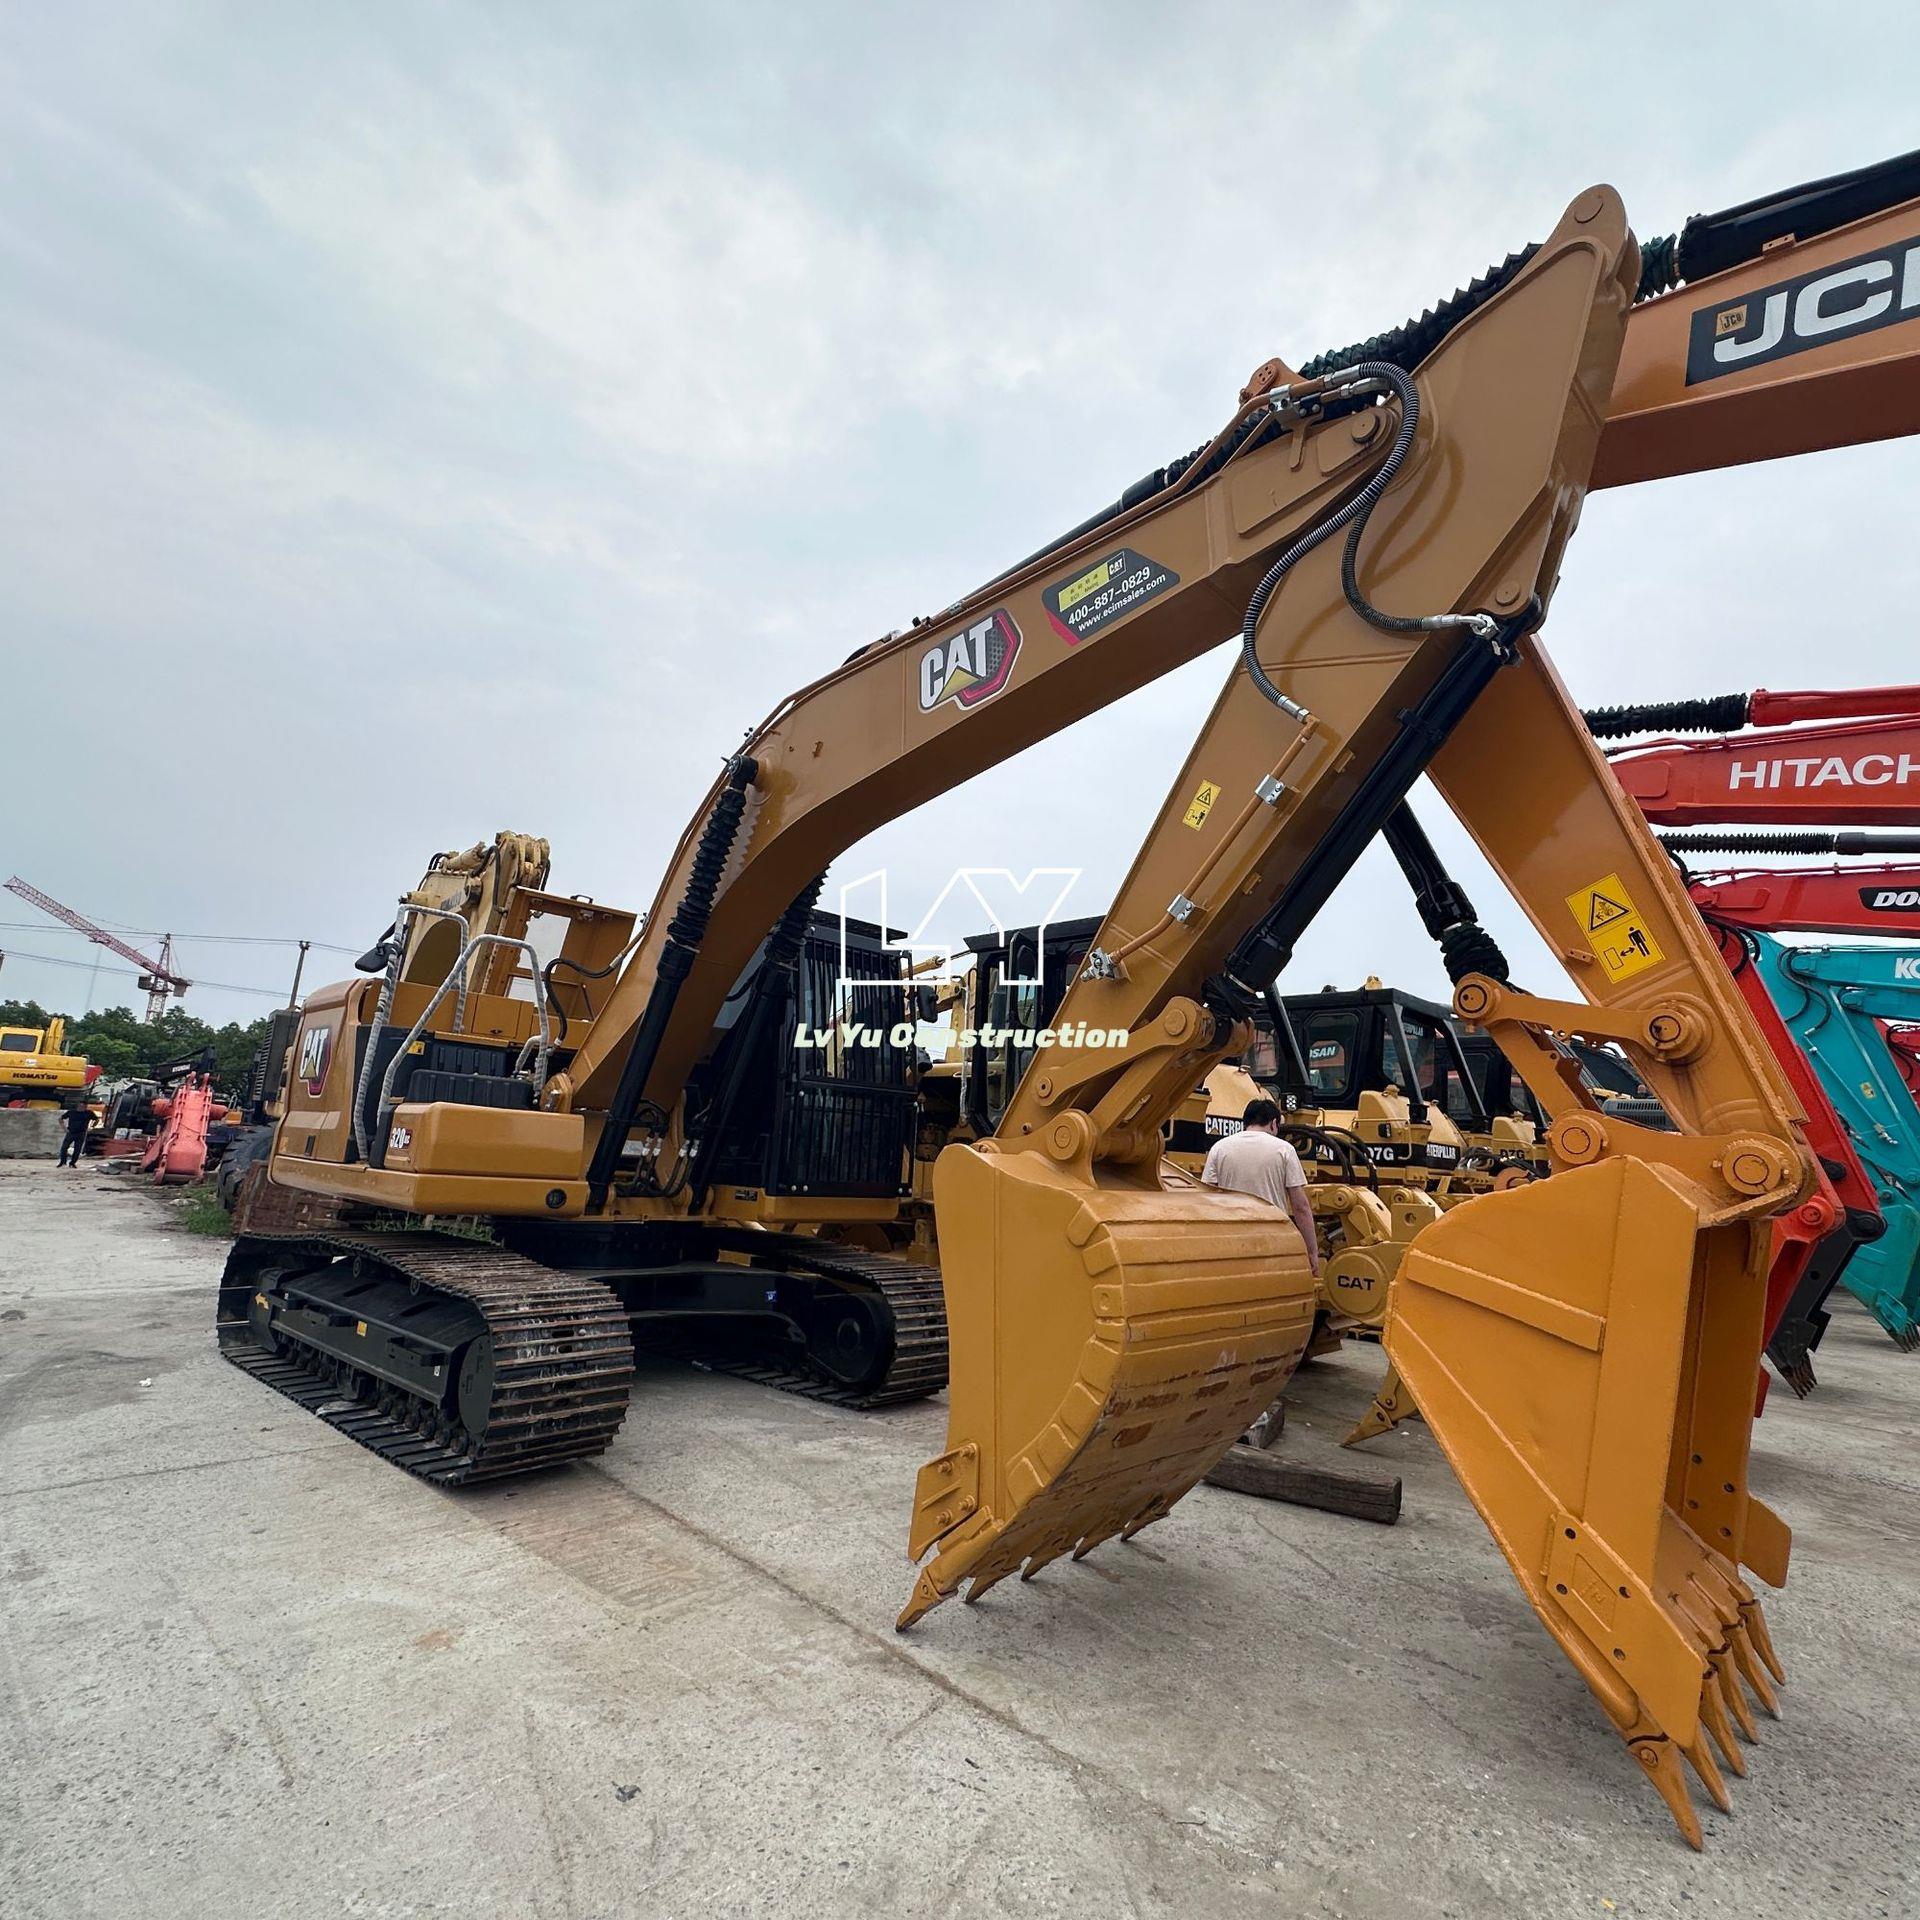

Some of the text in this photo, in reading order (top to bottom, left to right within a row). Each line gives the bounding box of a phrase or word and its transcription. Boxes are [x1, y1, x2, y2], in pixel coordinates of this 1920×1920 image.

[1713, 248, 1920, 362] JC
[1109, 558, 1123, 576] CAT
[1068, 566, 1150, 625] 400-887-0829
[1078, 574, 1166, 631] www.ecimsales.com
[921, 616, 993, 708] CAT
[1873, 892, 1920, 907] DO
[12, 1072, 58, 1080] KOMATSU
[301, 1028, 329, 1078] CAT
[1337, 1275, 1375, 1291] CAT
